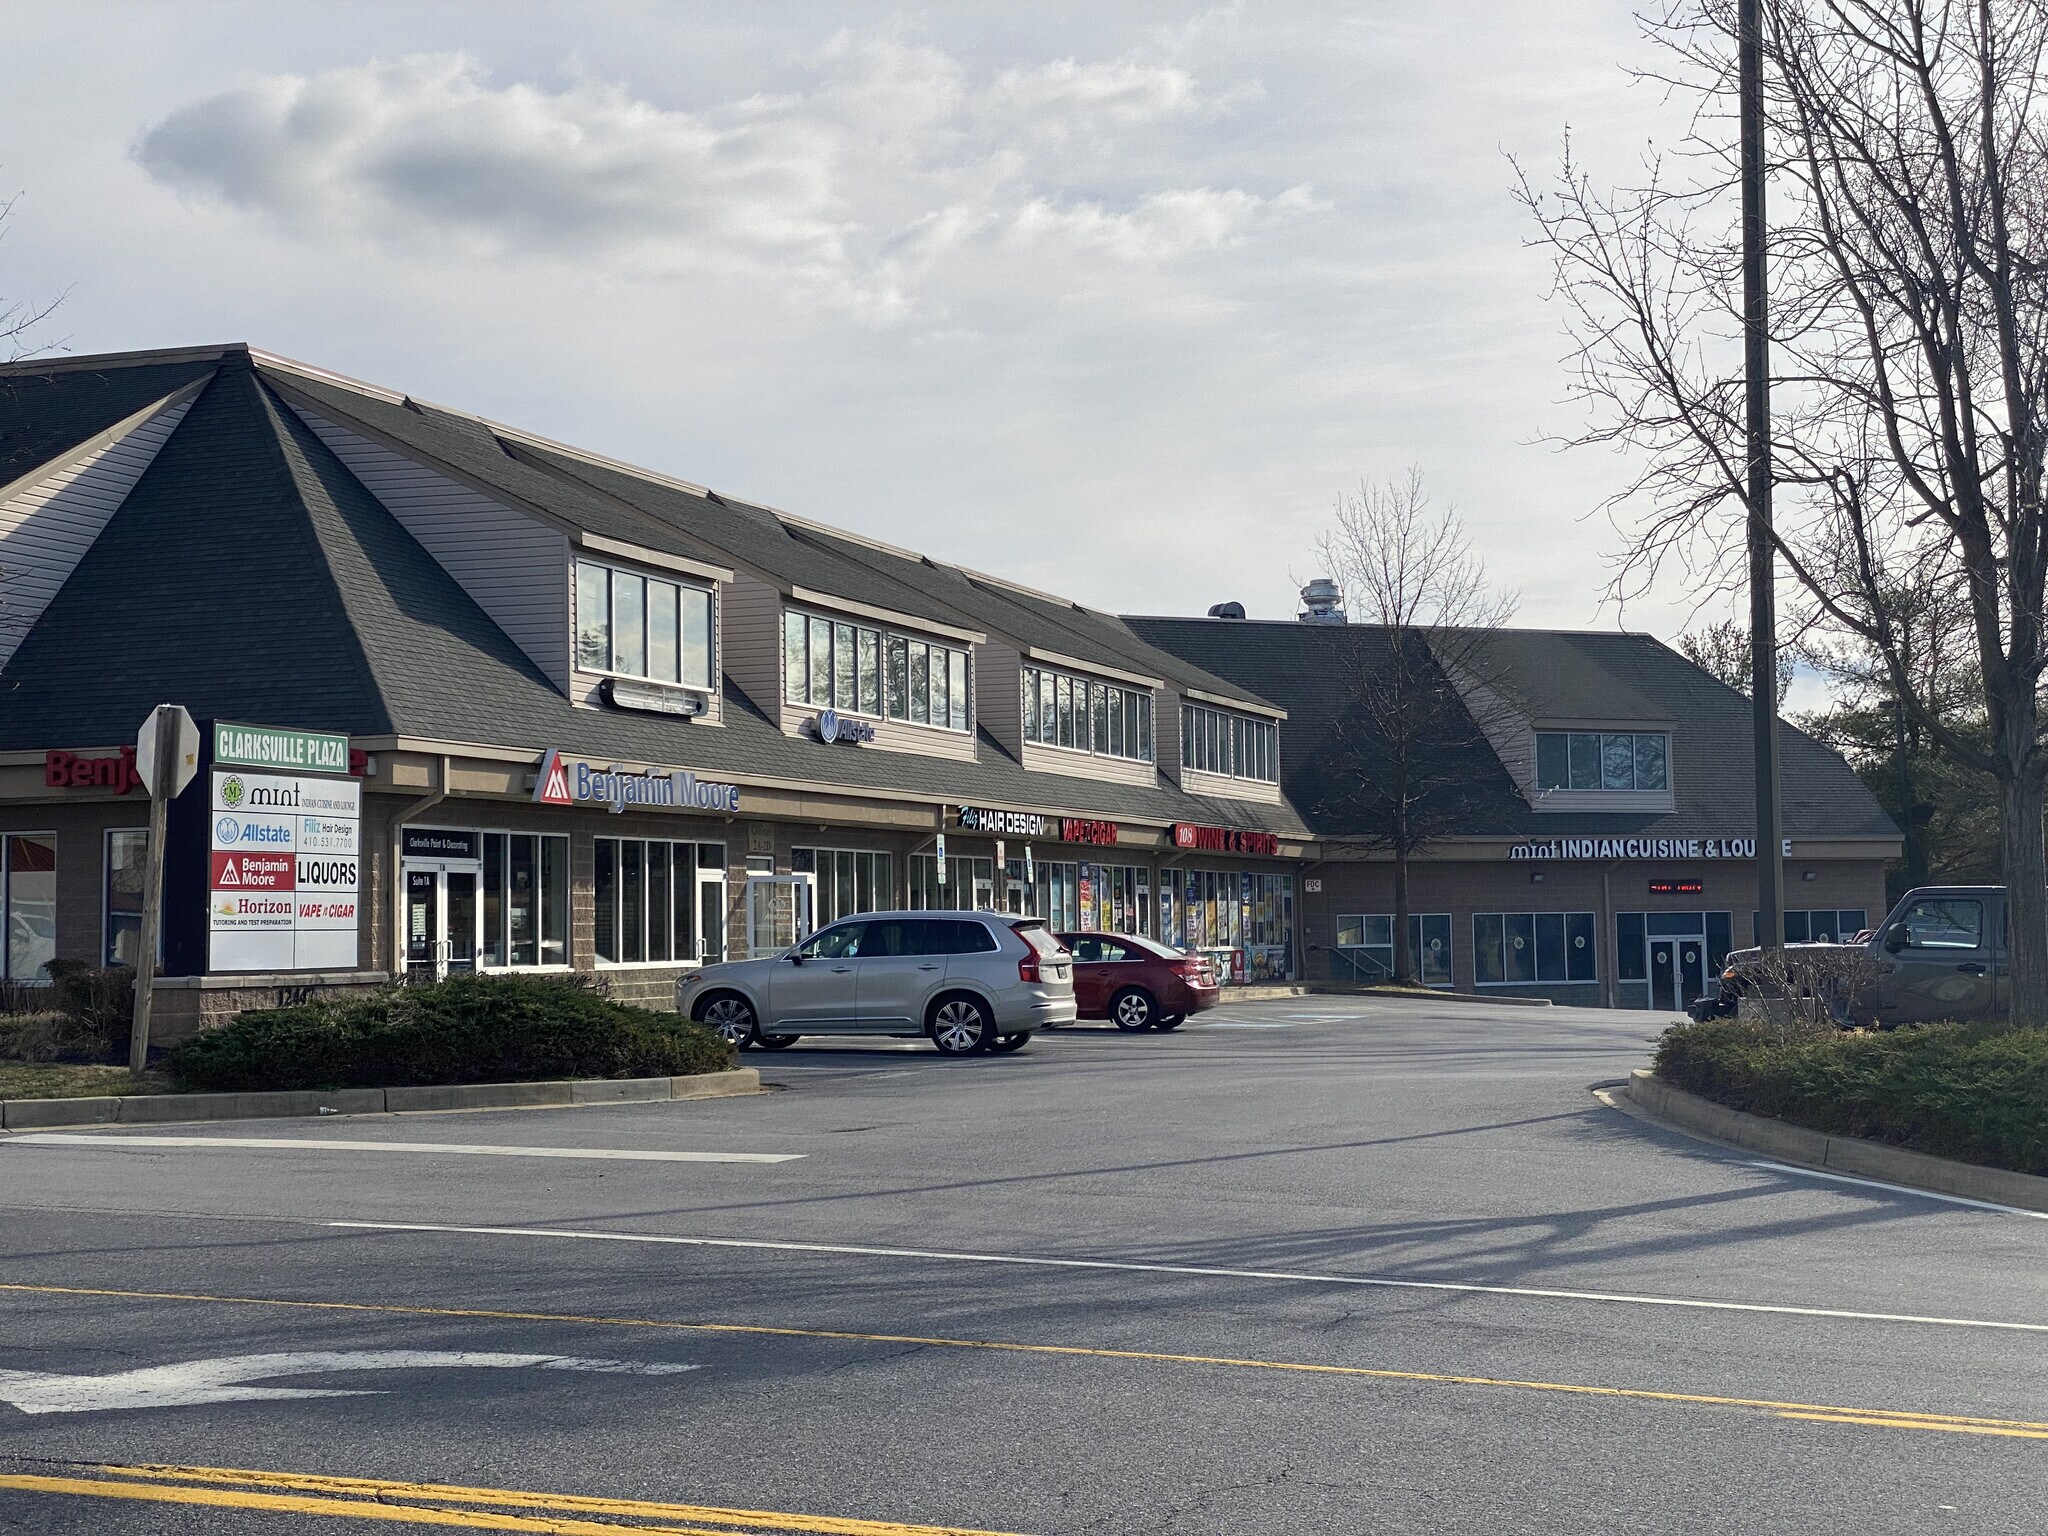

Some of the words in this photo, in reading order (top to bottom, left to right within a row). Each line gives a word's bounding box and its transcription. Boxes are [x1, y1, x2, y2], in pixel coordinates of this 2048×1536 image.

[840, 719, 875, 742] Allstate
[219, 730, 304, 763] CLARKSVILLE
[307, 739, 344, 767] PLAZA
[45, 744, 142, 795] Benj
[249, 781, 301, 807] mint
[577, 762, 675, 814] Benjamin
[679, 772, 740, 812] Moore
[240, 824, 291, 843] Allstate
[304, 818, 321, 833] Filiz
[322, 823, 333, 833] Hair
[334, 824, 353, 836] Design
[979, 810, 1005, 833] HAIR
[1006, 812, 1045, 836] DESIGN
[1062, 818, 1085, 843] VAPE
[1091, 820, 1118, 846] CIGAR
[303, 836, 353, 848] 410.531.7700
[1179, 827, 1193, 844] 108
[1199, 827, 1225, 851] WINE
[1228, 830, 1236, 853] &
[1240, 831, 1278, 855] SPIRITS
[1510, 839, 1557, 859] mint
[1561, 839, 1624, 858] INDIAN
[1626, 839, 1699, 858] CUISINE
[1704, 839, 1717, 858] &
[1722, 839, 1792, 858] LOUE
[242, 858, 289, 876] Benjamin
[297, 861, 356, 885] LIQUORS
[242, 872, 275, 886] Moore
[1306, 880, 1320, 888] FDC
[238, 899, 292, 914] Horizon
[299, 904, 322, 918] VAPE
[328, 904, 355, 918] CIGAR
